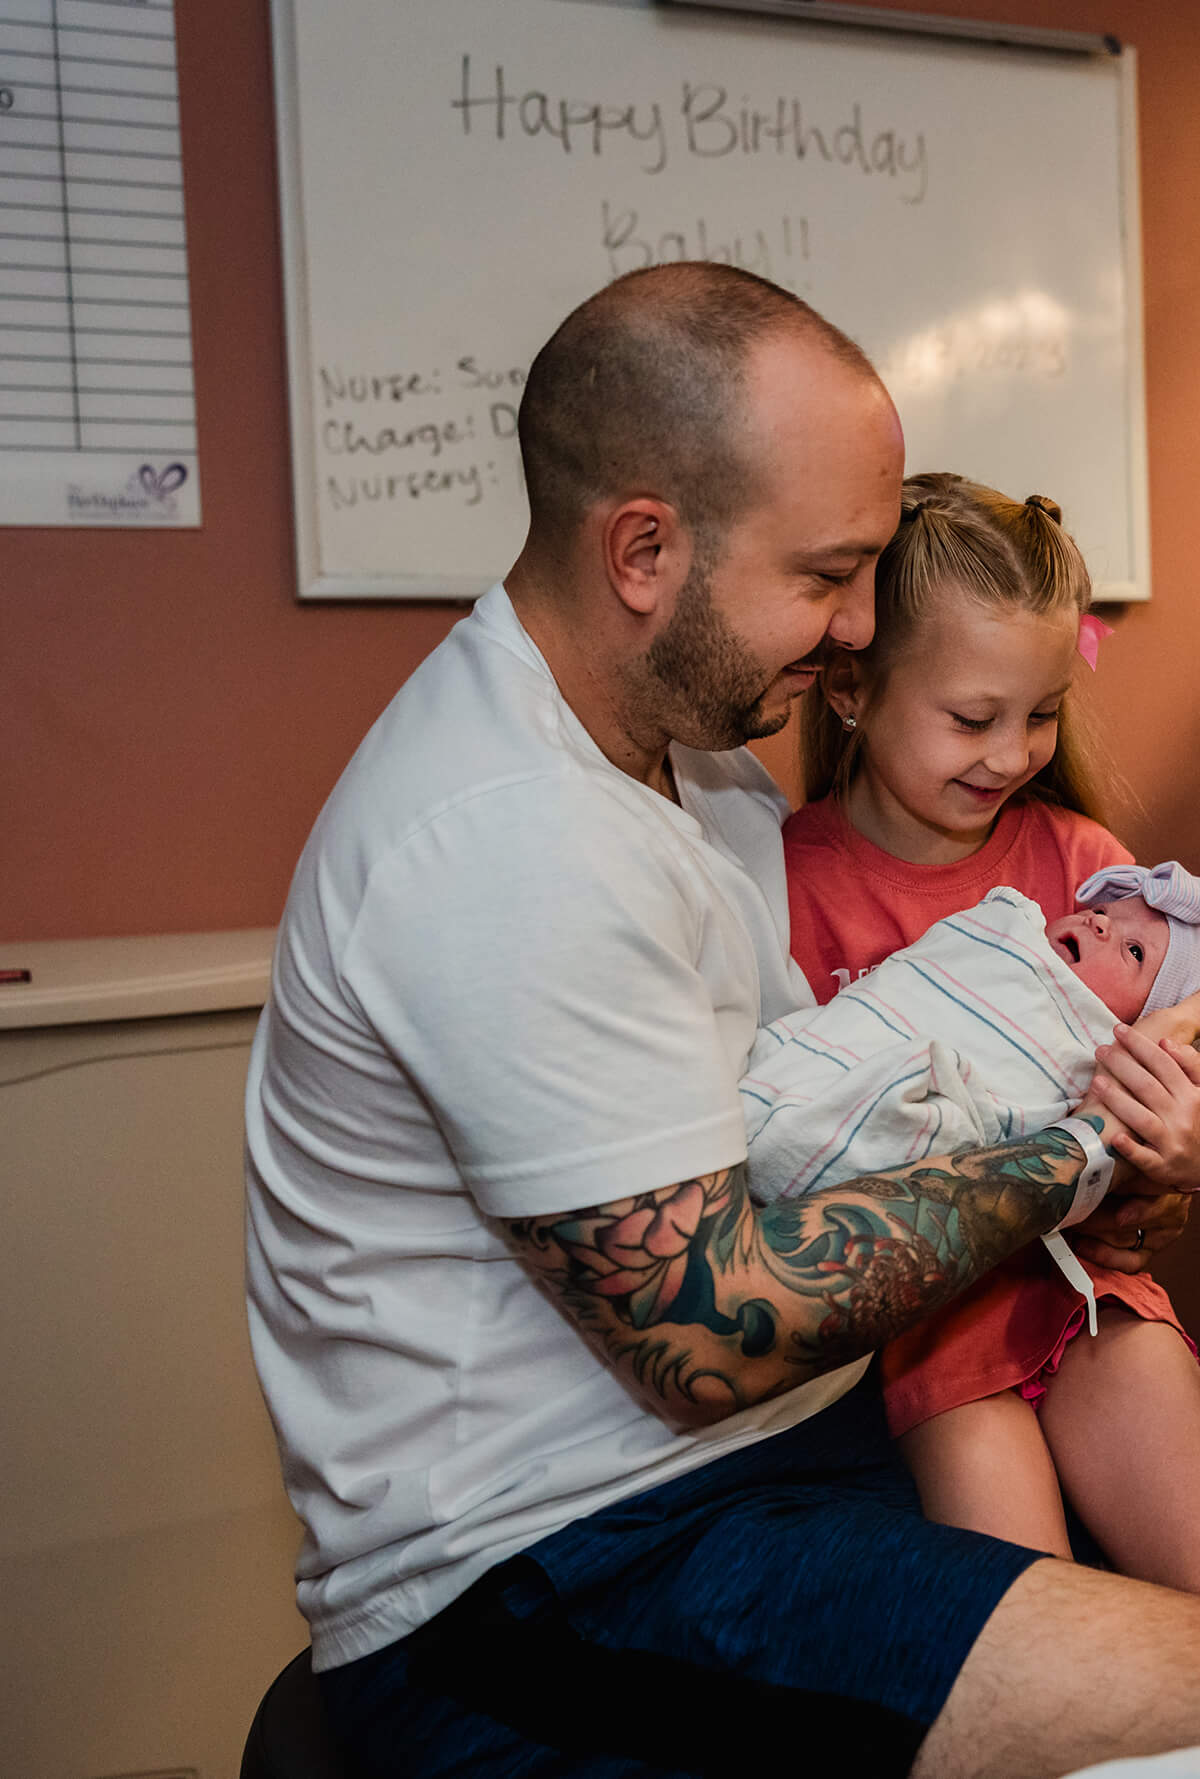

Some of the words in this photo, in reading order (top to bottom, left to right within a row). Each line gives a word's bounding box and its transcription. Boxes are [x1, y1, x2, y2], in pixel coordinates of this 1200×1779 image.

[451, 54, 665, 176] Happy
[682, 80, 930, 203] Birthday
[319, 364, 442, 408] Nurse:
[322, 410, 476, 458] Charge:
